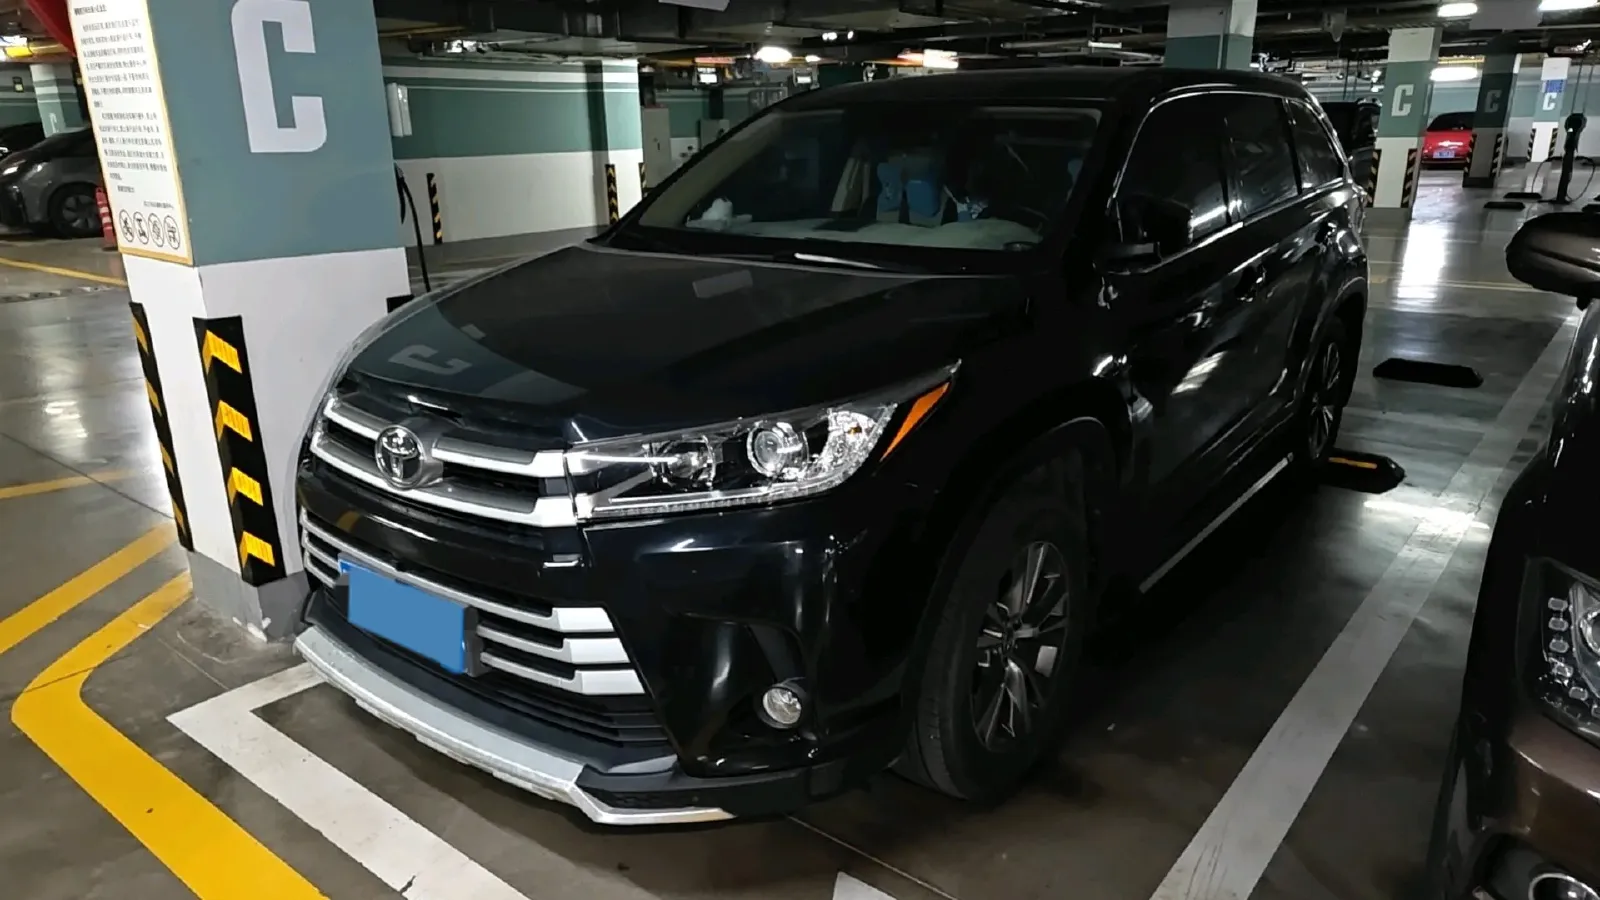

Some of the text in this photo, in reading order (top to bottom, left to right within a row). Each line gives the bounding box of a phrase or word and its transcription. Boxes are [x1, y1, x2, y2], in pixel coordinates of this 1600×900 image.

[231, 0, 327, 153] C
[1391, 84, 1414, 117] C
[1484, 90, 1501, 113] C
[1542, 92, 1557, 111] C
